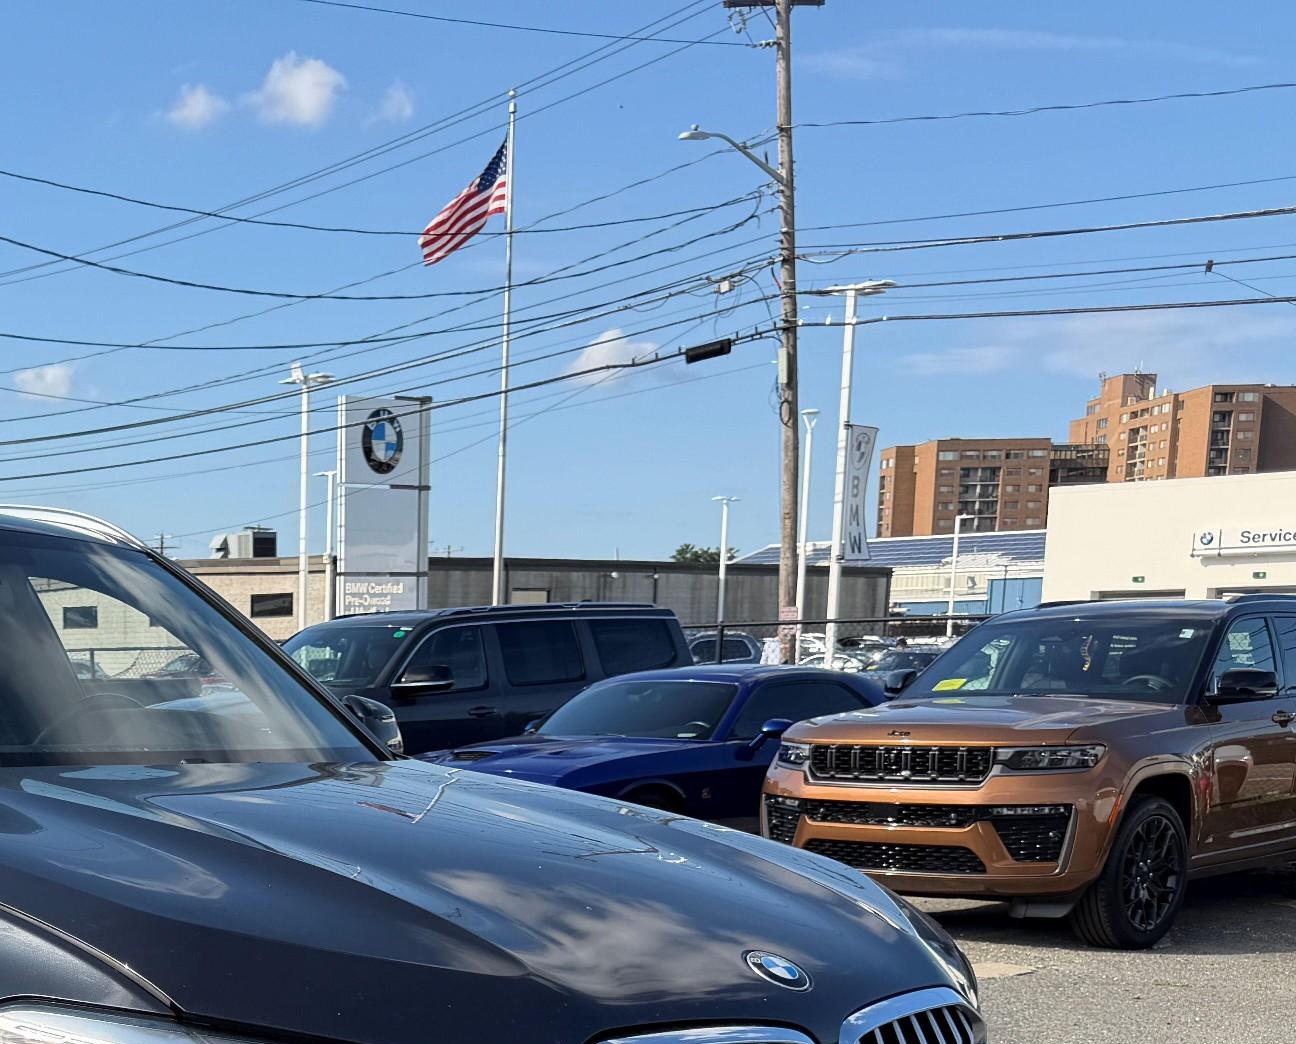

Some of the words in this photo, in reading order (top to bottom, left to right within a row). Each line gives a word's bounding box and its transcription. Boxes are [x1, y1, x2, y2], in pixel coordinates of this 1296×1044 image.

[849, 475, 862, 554] BMW
[345, 582, 368, 594] BMW
[369, 582, 403, 594] Certified
